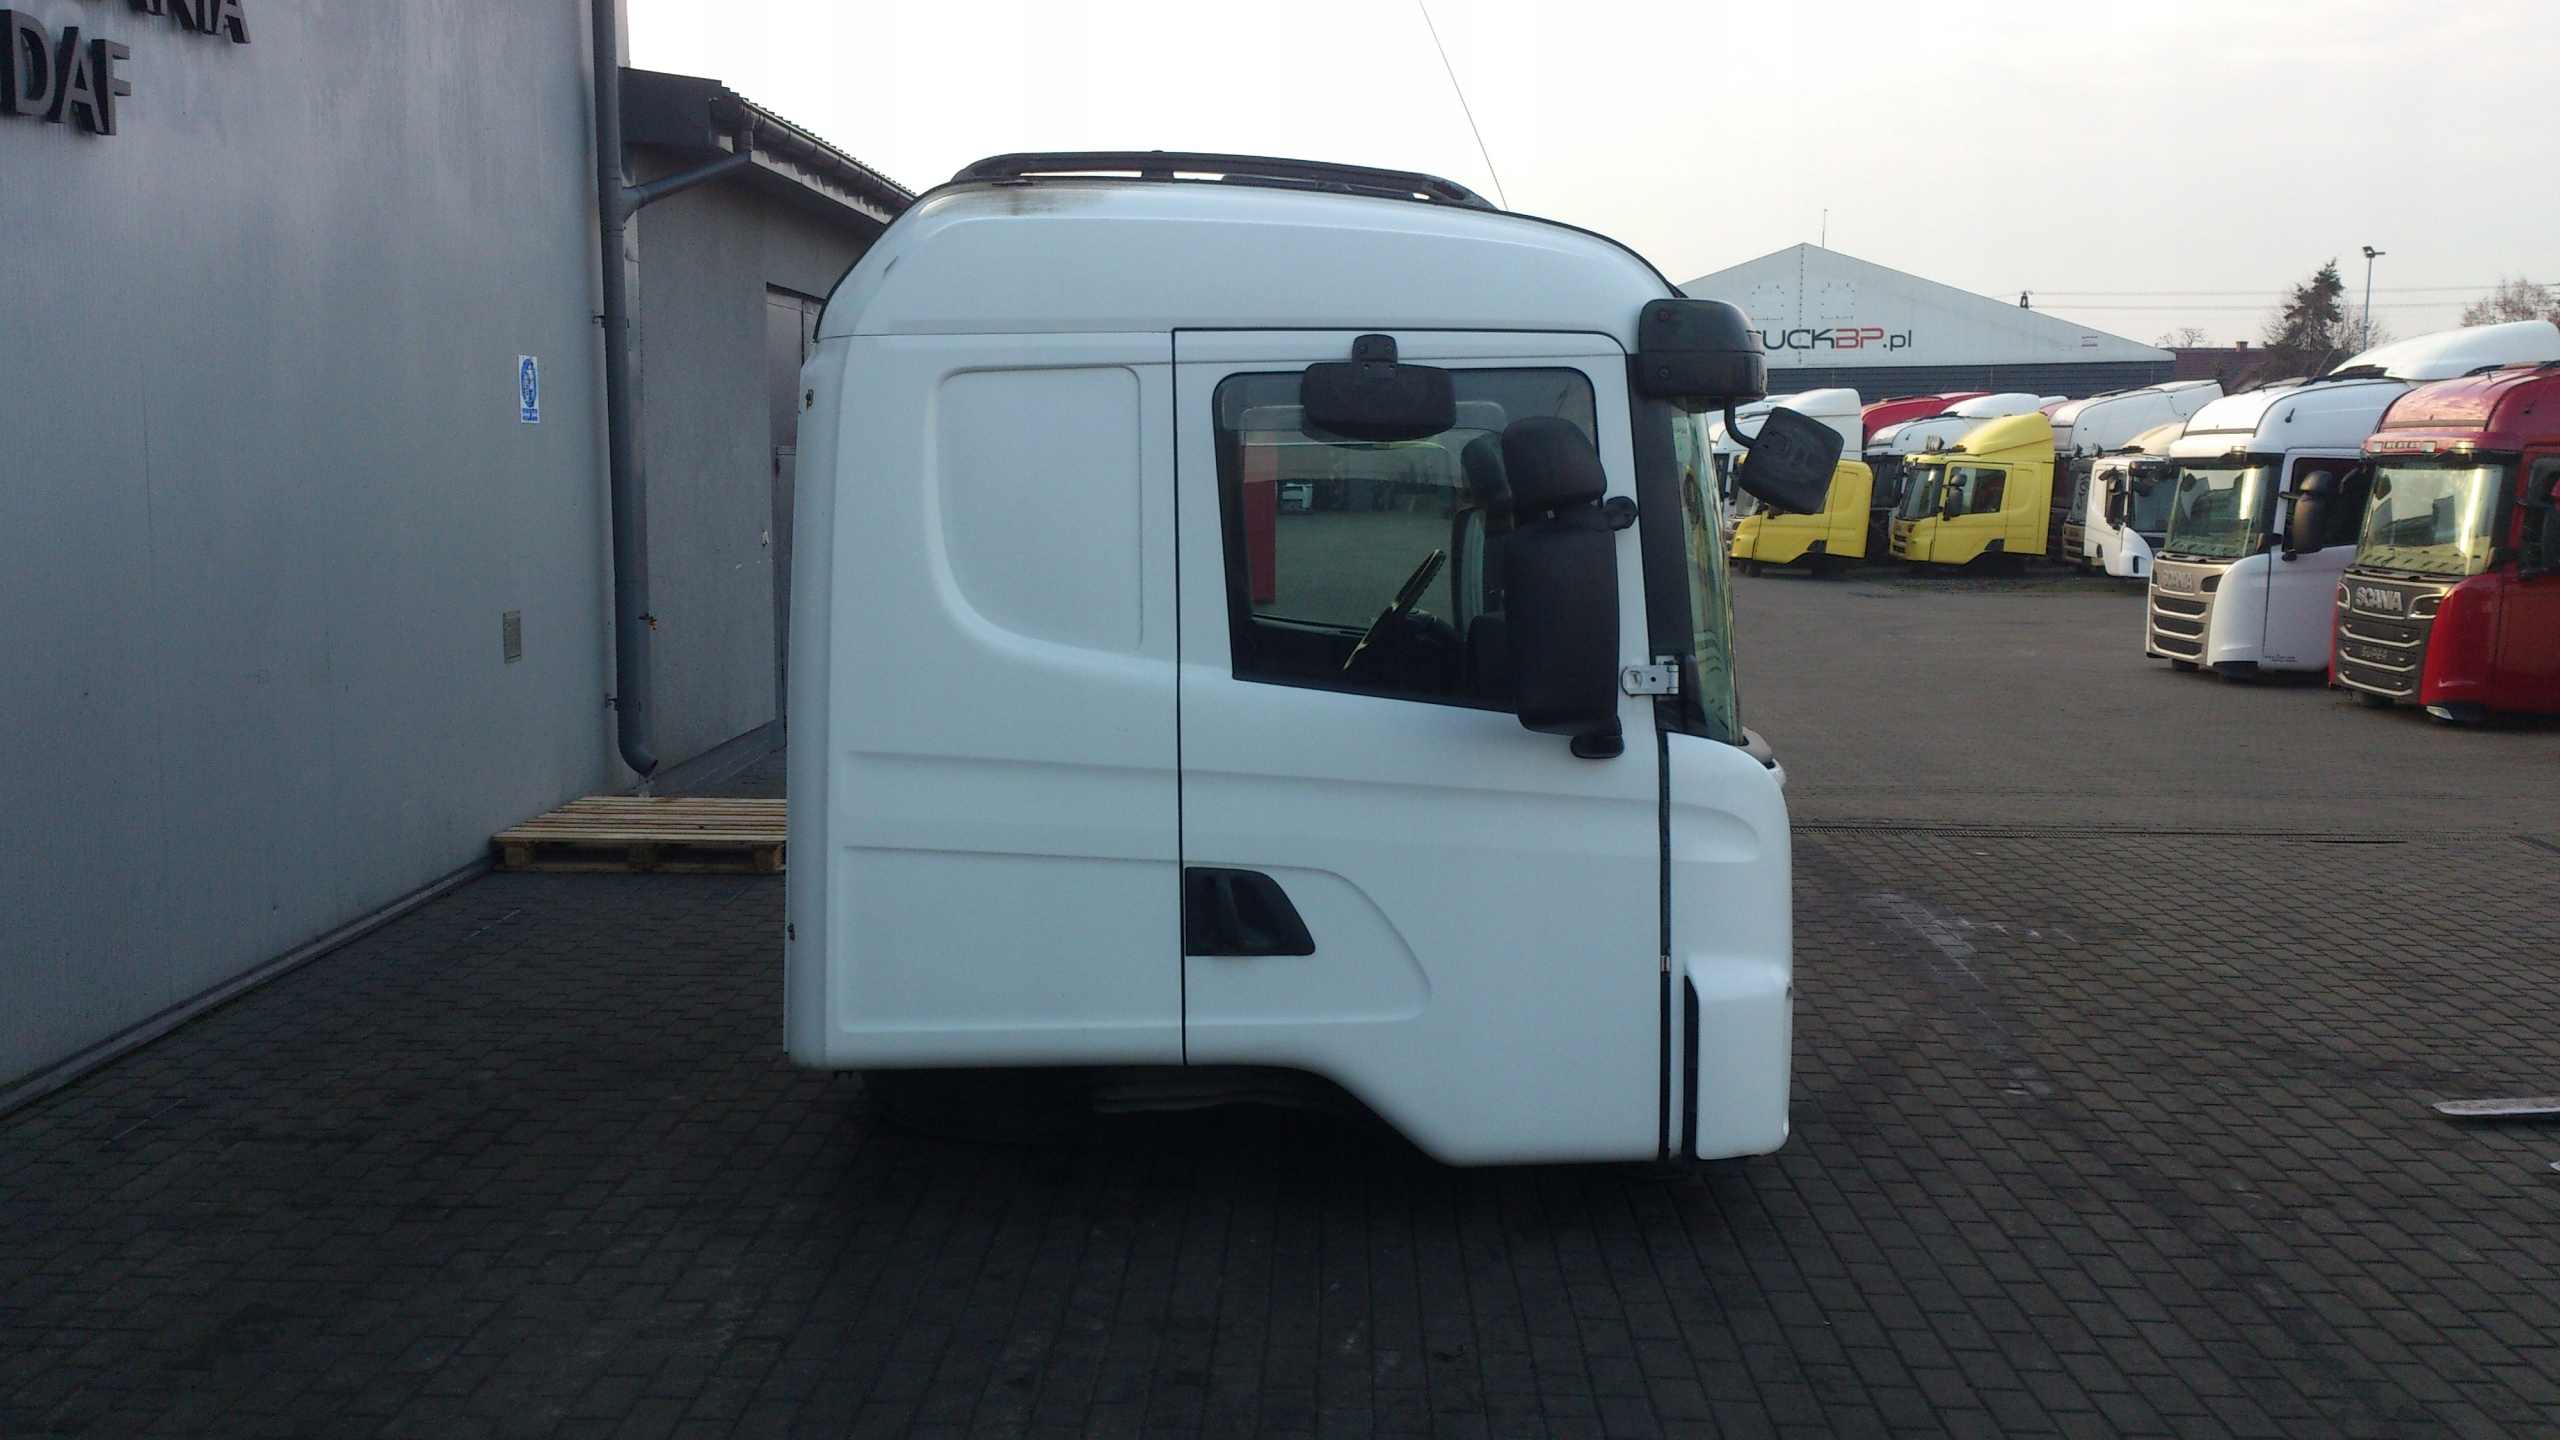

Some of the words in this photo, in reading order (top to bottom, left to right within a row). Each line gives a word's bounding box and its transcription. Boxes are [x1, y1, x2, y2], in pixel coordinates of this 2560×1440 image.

[0, 9, 131, 136] DAF
[1755, 327, 1912, 352] UCKBP.pl
[2161, 569, 2194, 590] SCANIA
[2355, 586, 2403, 612] SCANIA
